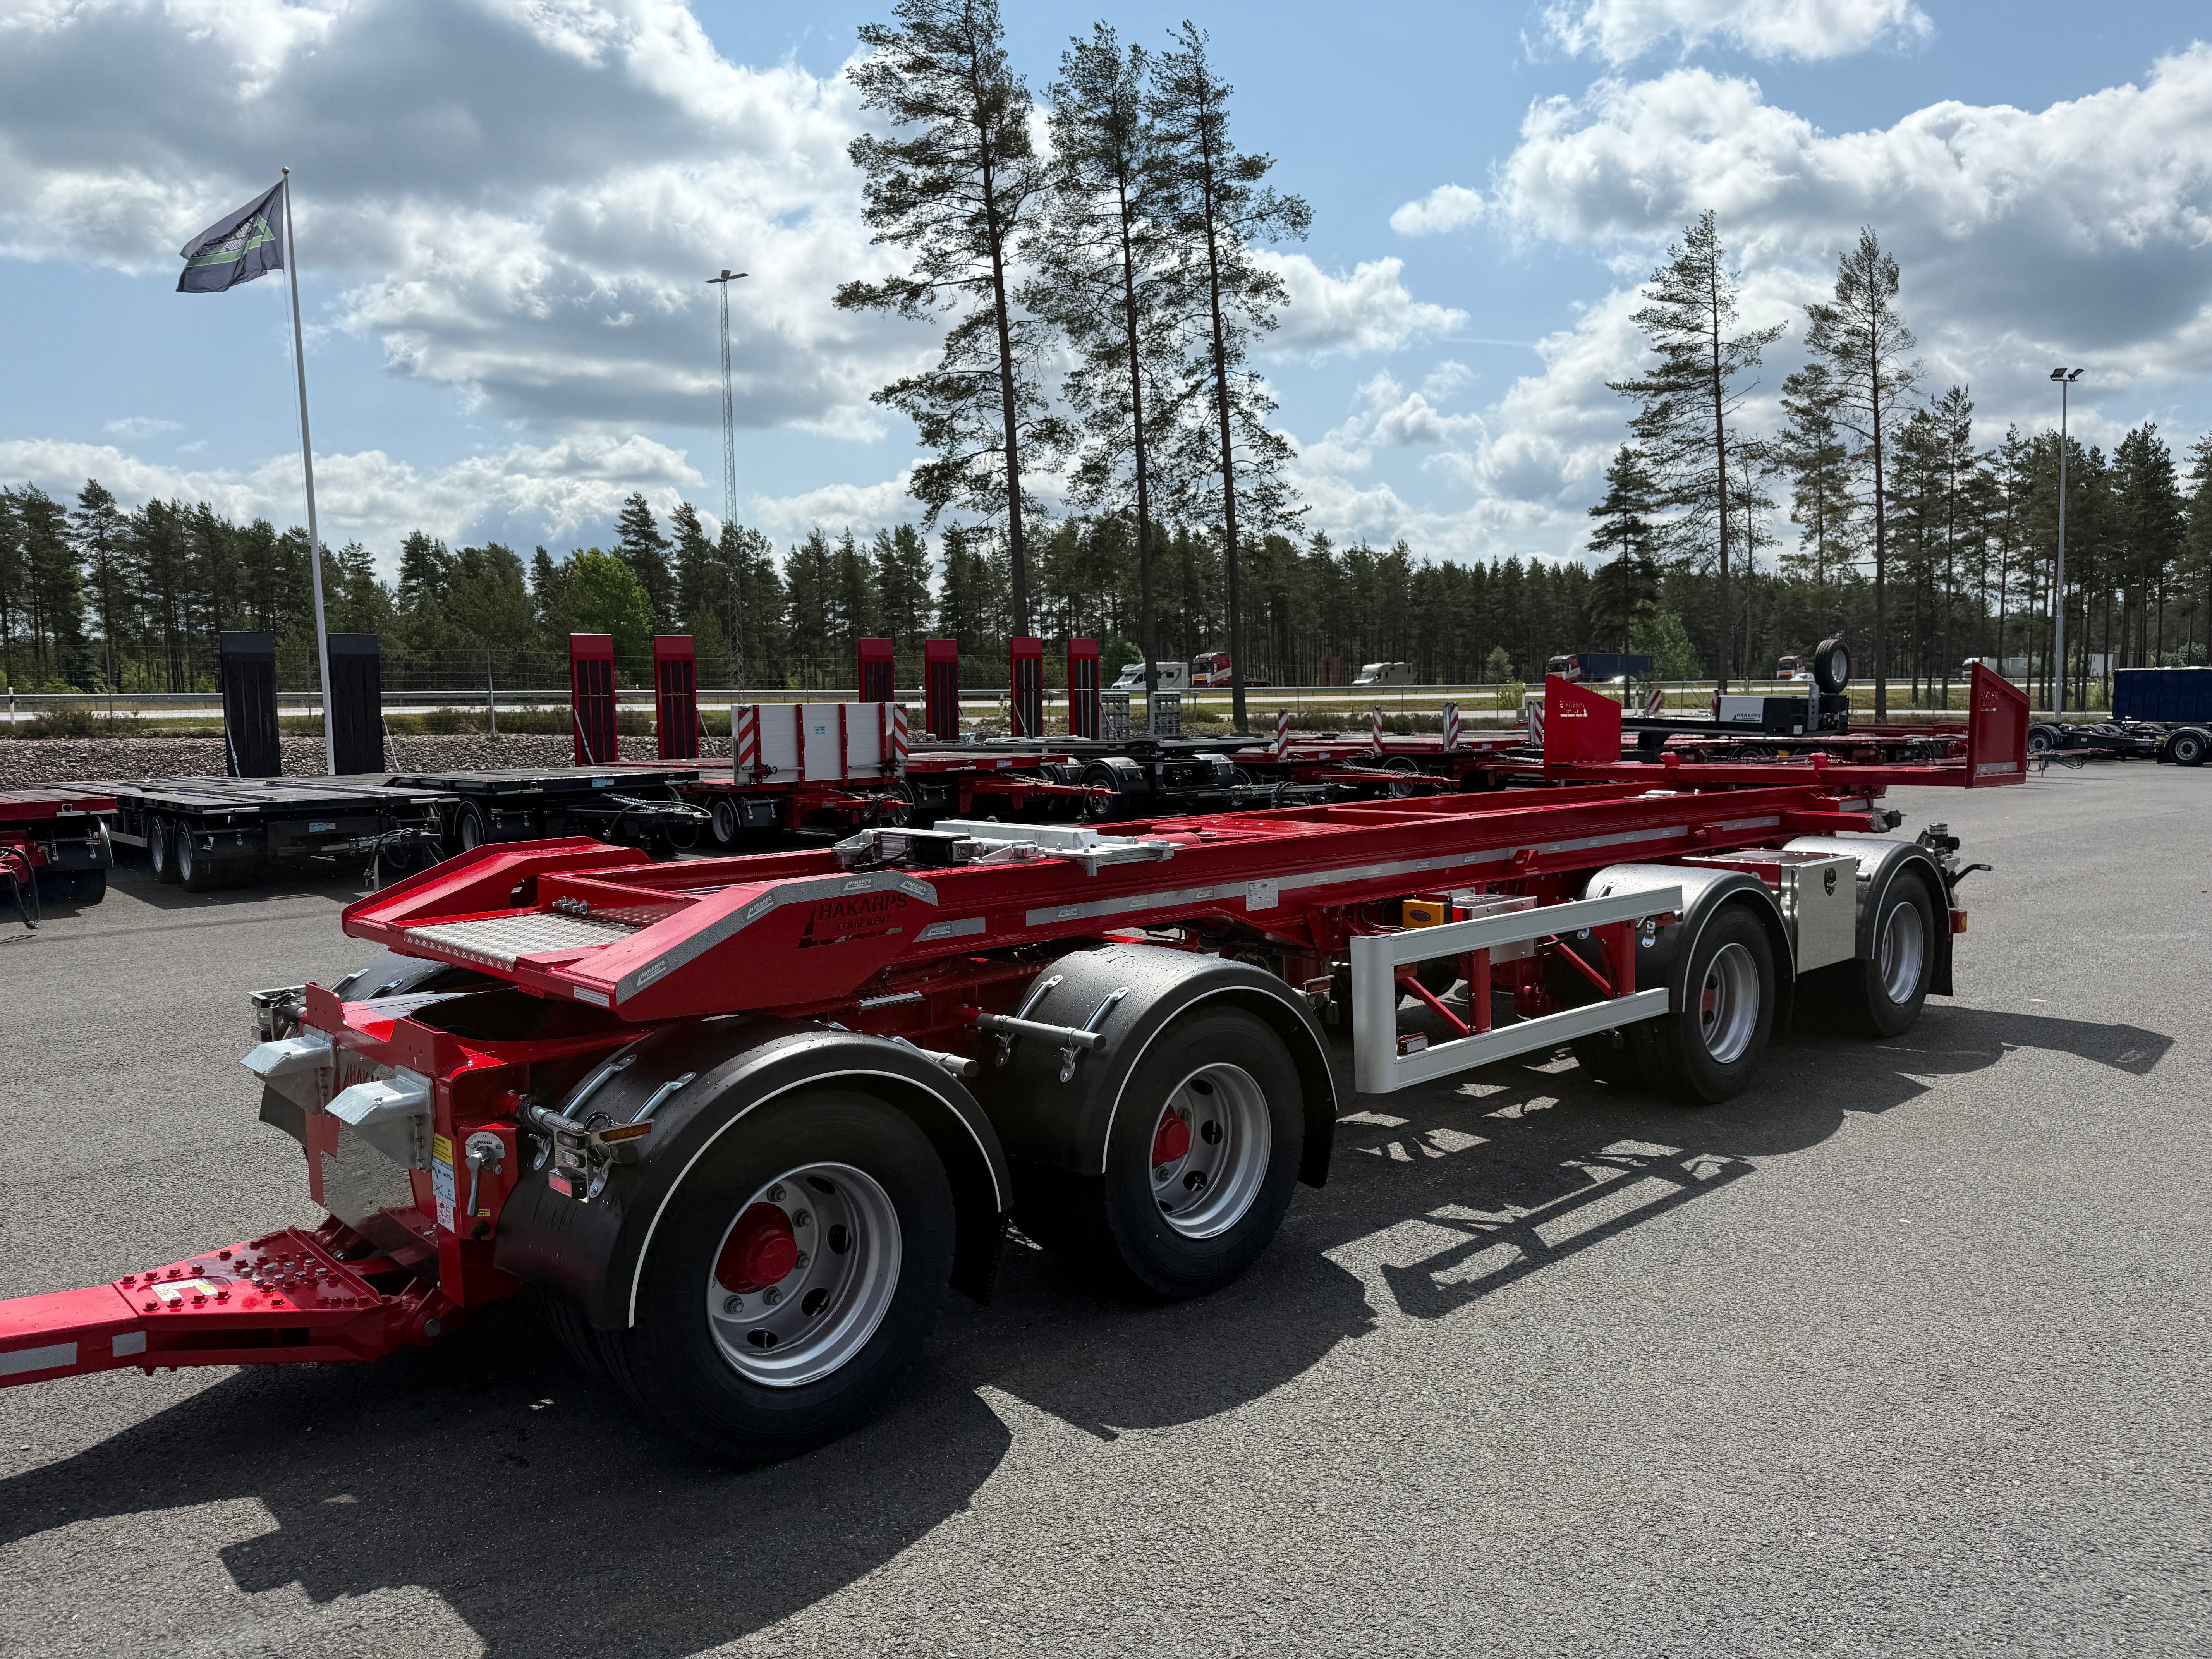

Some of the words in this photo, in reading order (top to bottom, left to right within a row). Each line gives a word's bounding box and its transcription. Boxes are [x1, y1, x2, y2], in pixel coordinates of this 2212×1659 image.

[905, 880, 927, 891] HAKARPS
[750, 896, 772, 912] HAKARPS
[819, 892, 908, 920] HAKARPS
[837, 915, 892, 931] EQUIPMENT
[640, 960, 665, 978] HAKARPS
